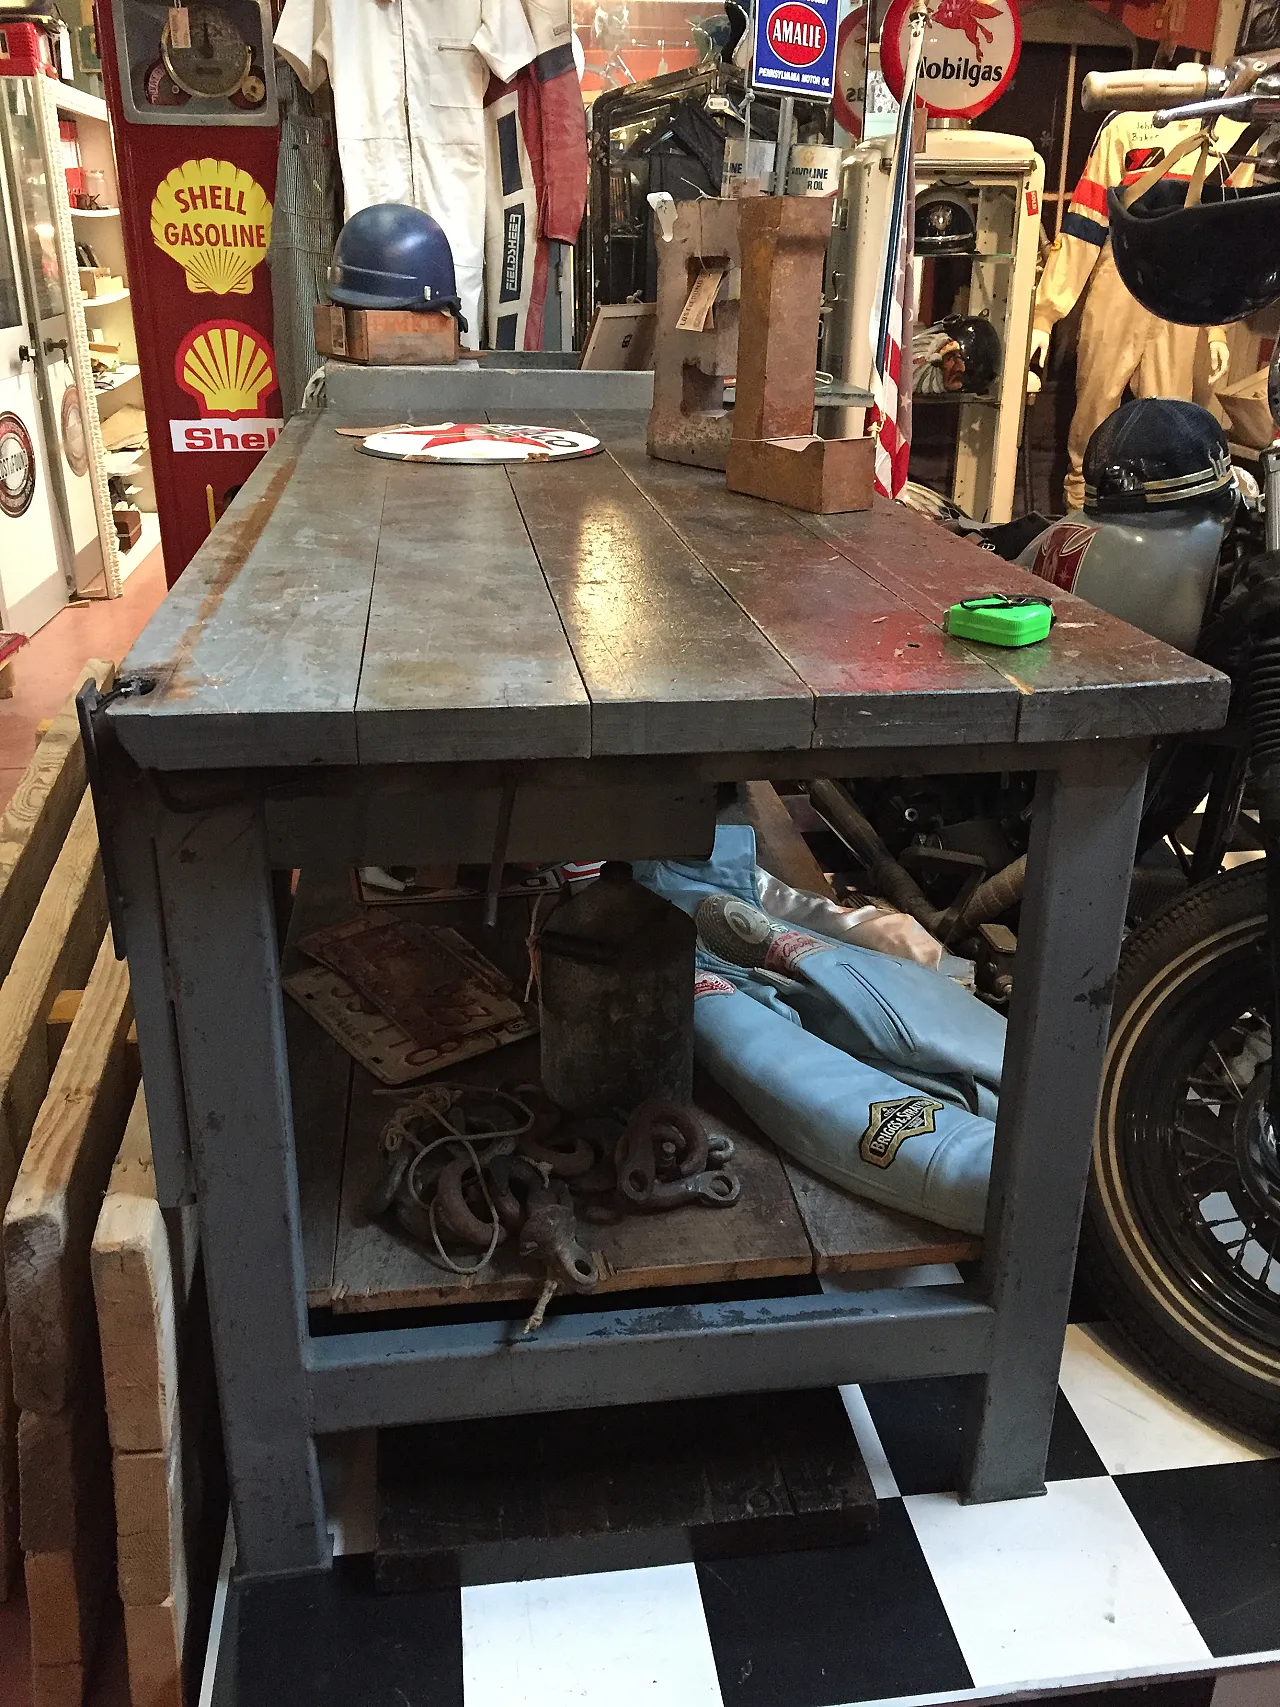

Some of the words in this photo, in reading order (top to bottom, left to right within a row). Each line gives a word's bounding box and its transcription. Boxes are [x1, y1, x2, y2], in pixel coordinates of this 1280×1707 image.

[772, 18, 822, 49] AMALIE
[758, 67, 800, 82] PENNSYLVANIA
[801, 74, 820, 85] MOTOR
[821, 77, 830, 87] OIL
[174, 185, 247, 215] SHELL
[164, 222, 266, 247] GASOLINE
[870, 1120, 900, 1153] BRIGGS
